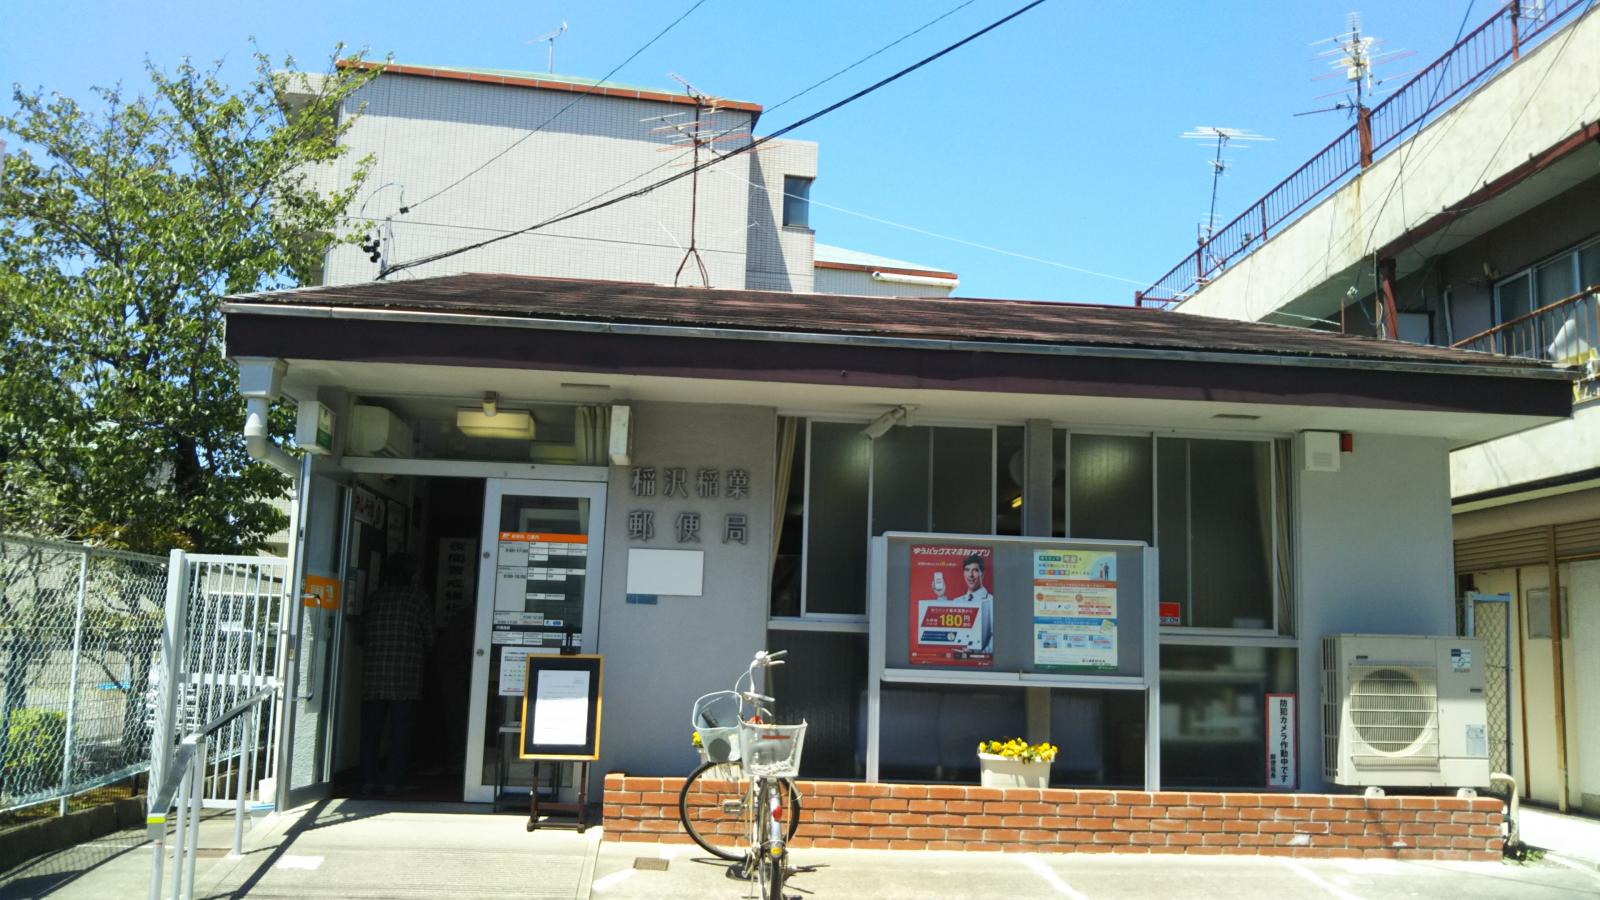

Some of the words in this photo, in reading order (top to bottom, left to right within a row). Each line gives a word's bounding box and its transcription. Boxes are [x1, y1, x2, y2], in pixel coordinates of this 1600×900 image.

[632, 467, 749, 498] 稲沢稲葉
[628, 511, 747, 545] 郵便局
[1280, 699, 1288, 783] 防犯カメラ作動中です
